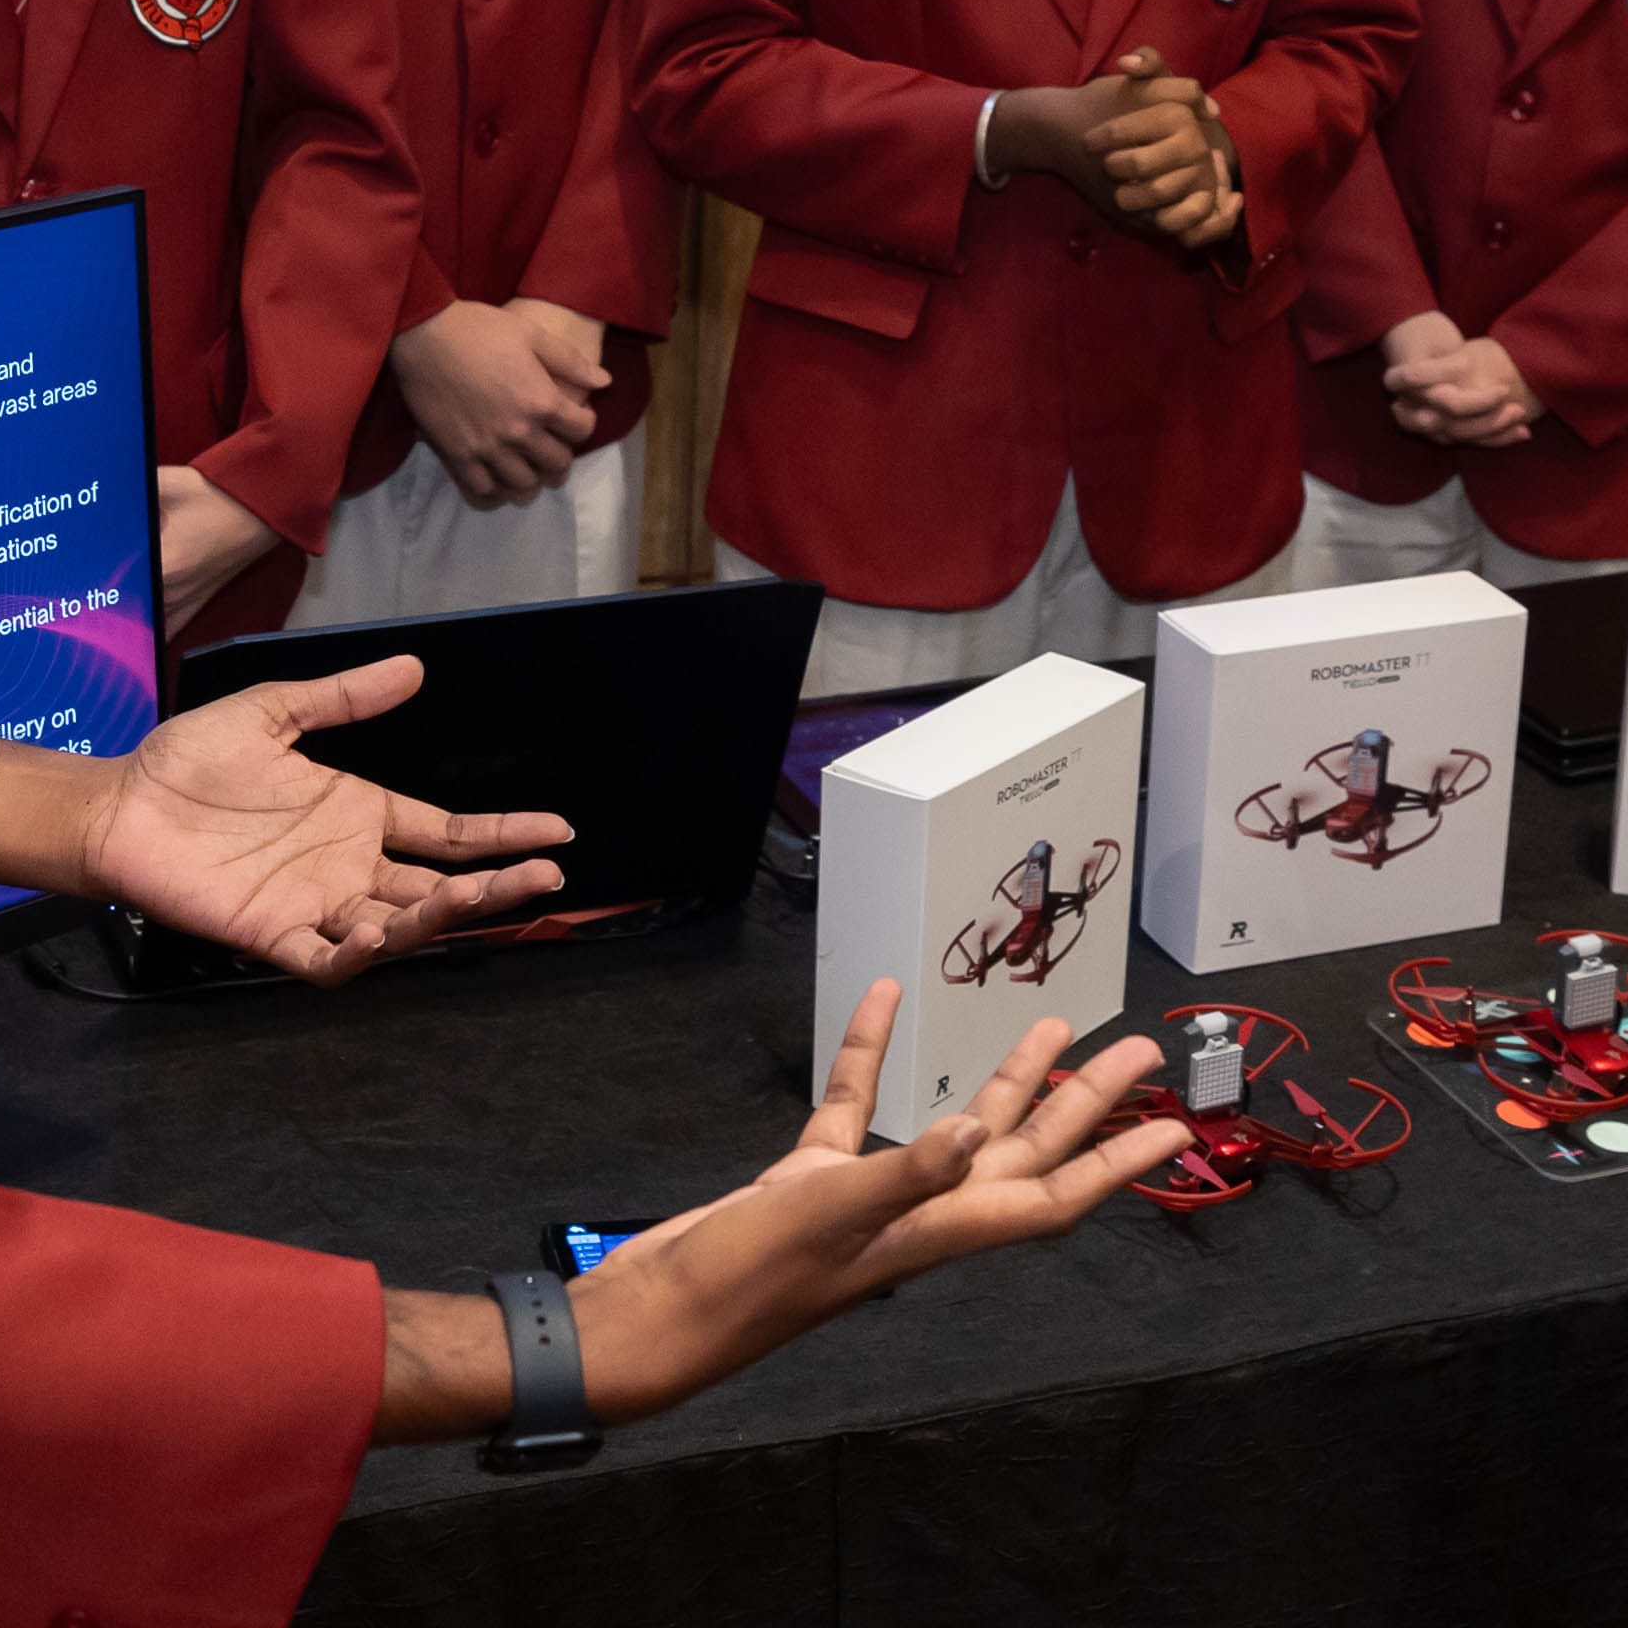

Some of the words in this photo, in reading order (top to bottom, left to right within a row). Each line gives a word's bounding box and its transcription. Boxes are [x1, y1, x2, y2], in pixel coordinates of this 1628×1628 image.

[42, 379, 98, 406] areas
[77, 480, 99, 506] of
[59, 596, 81, 619] to
[86, 588, 120, 611] the
[1311, 655, 1411, 682] ROBOMASTER
[51, 707, 77, 728] on
[996, 756, 1068, 805] ROBOMASTER
